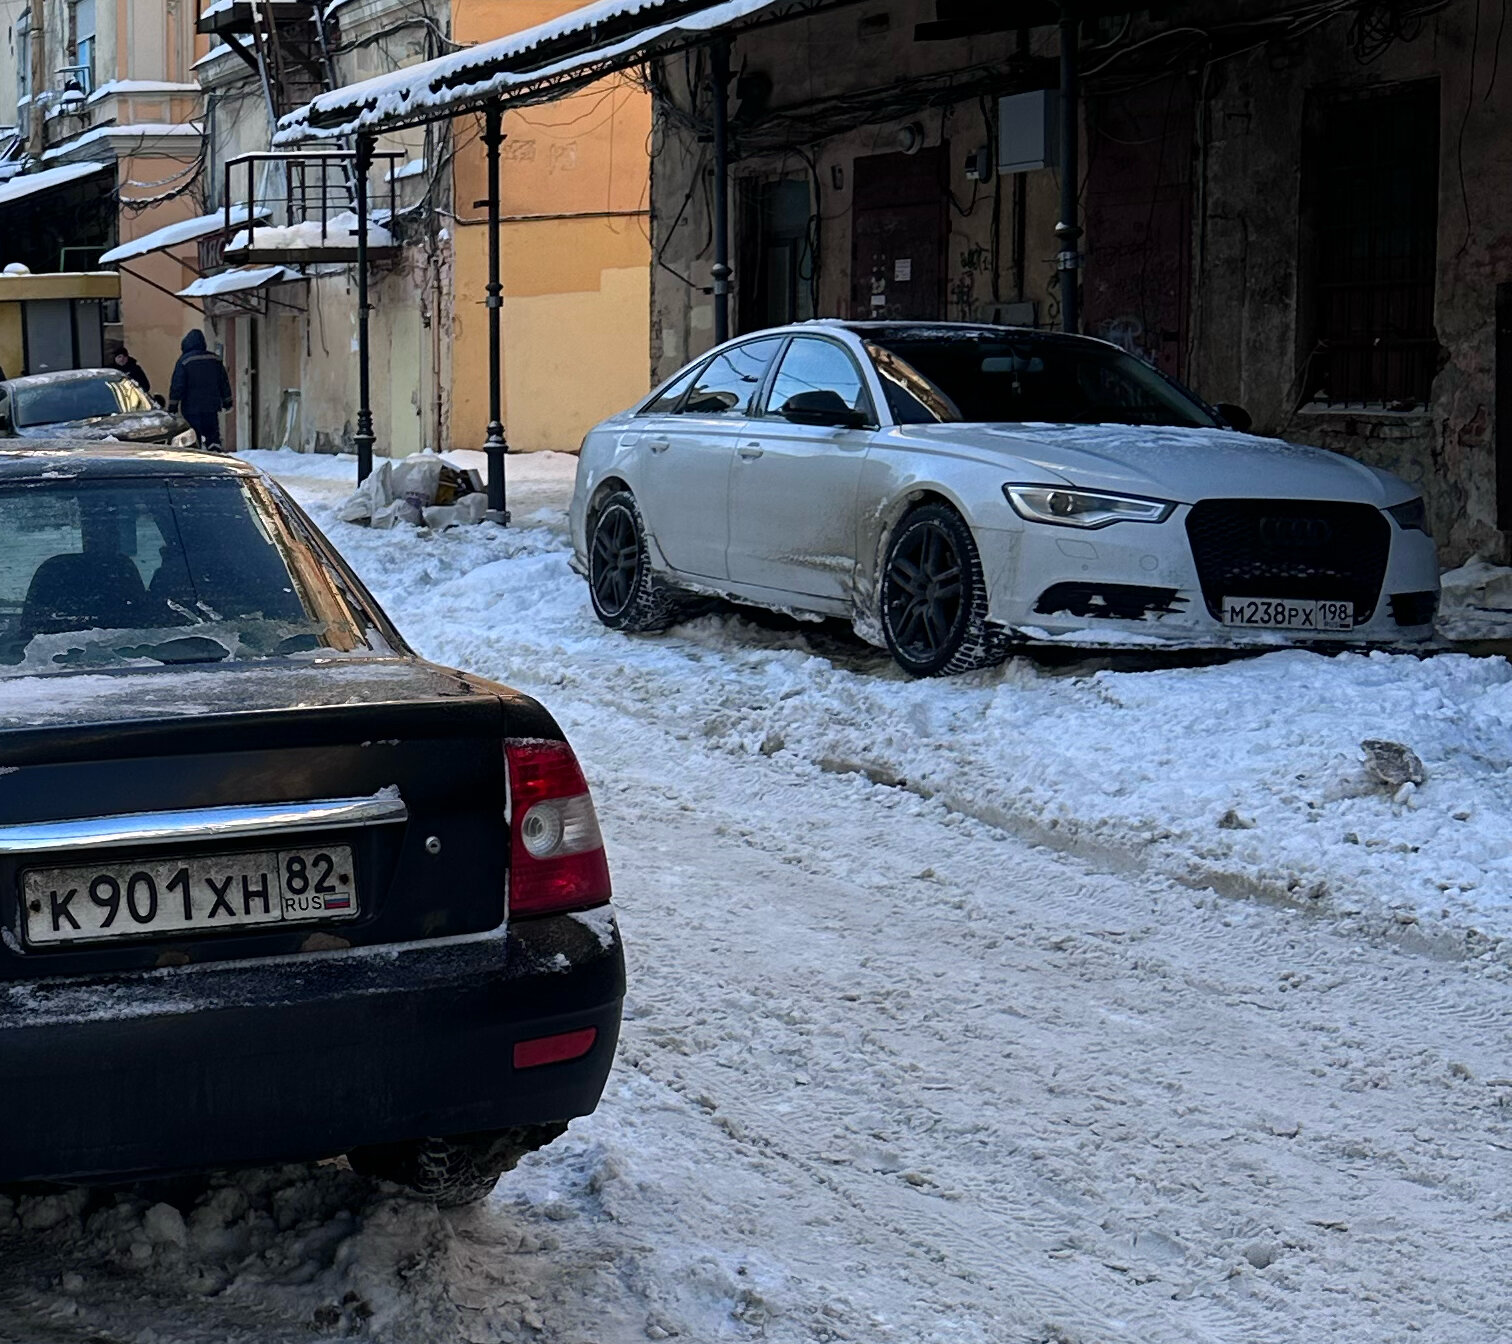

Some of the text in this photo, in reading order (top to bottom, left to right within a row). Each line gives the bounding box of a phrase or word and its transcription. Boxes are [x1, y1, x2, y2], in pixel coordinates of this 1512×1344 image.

[1319, 603, 1348, 621] 198
[285, 853, 337, 895] 82
[285, 895, 323, 912] RUS
